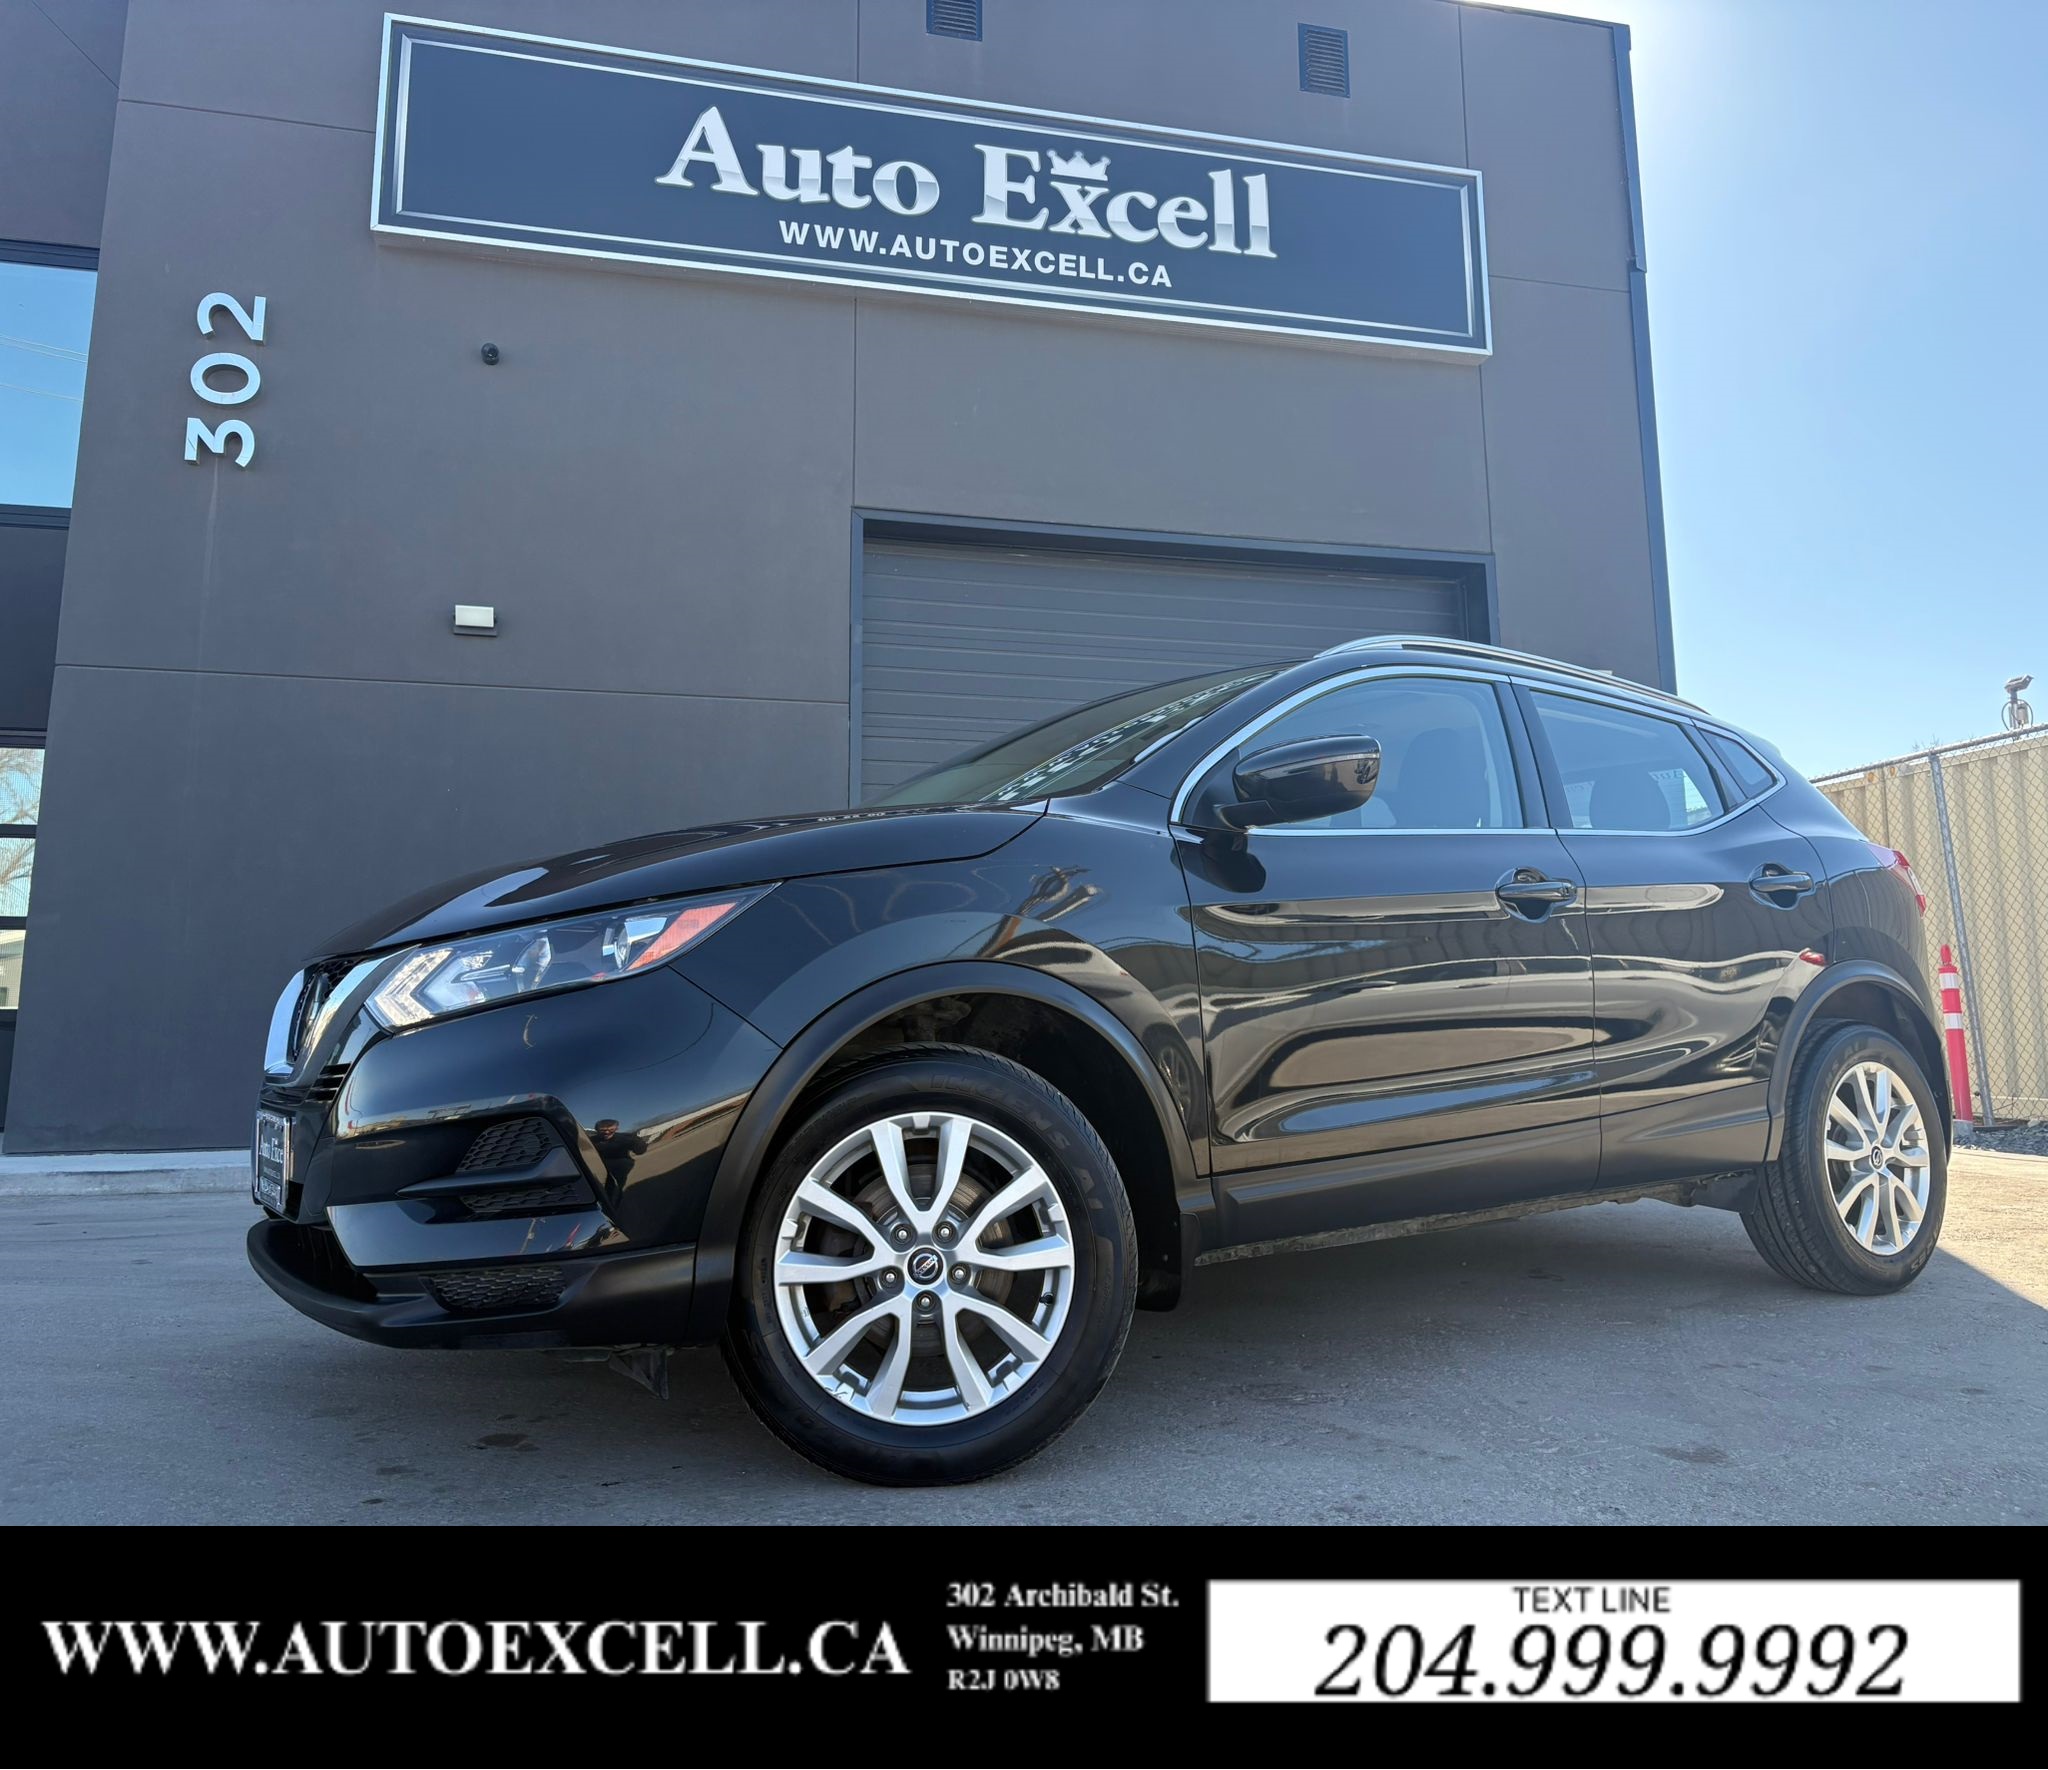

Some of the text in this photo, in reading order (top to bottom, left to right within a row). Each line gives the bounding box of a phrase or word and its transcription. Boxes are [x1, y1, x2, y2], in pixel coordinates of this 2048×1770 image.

[655, 105, 1278, 259] Auto Excell
[778, 219, 1173, 289] WWW.AUTOEXCELL.CA
[184, 291, 267, 468] 302
